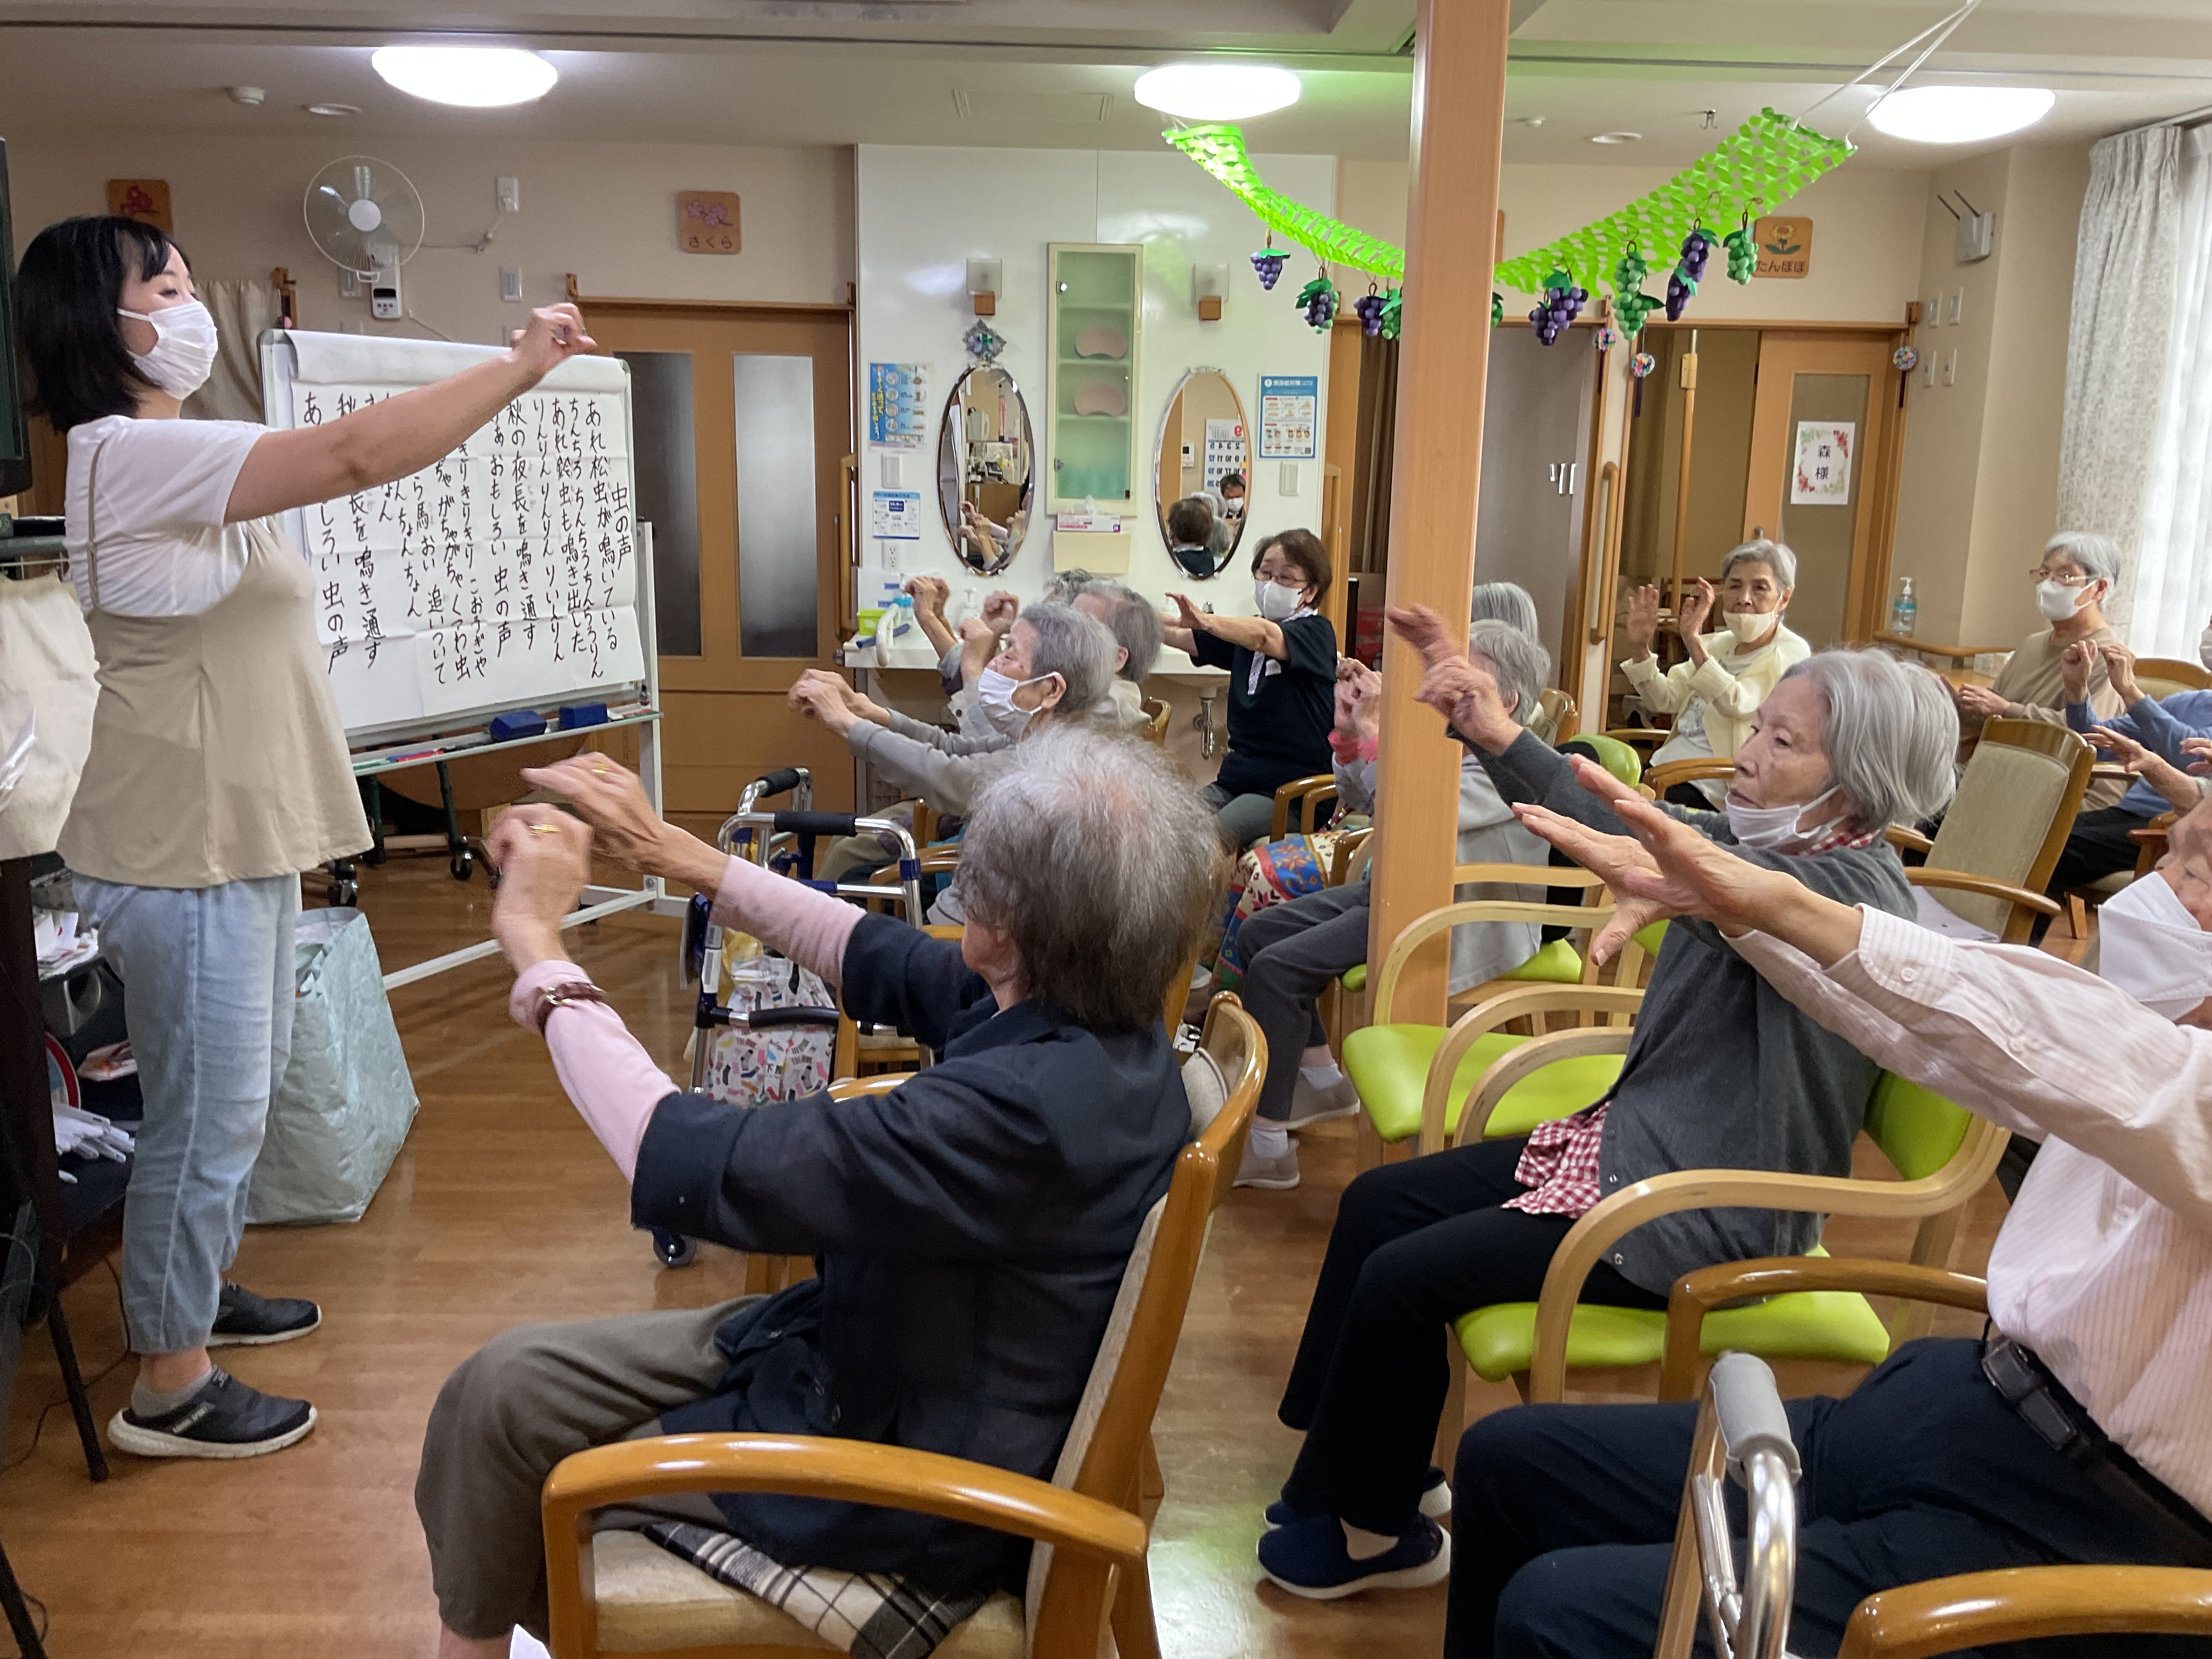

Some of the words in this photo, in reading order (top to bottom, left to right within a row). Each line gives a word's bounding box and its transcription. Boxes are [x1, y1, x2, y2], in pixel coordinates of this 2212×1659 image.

[689, 235, 732, 249] さくら
[414, 475, 445, 684] ら馬おい追いついて
[506, 398, 540, 650] 秋の夜長を鳴き通す
[552, 397, 587, 652] あれ鈴虫も鳴き出した
[585, 399, 617, 650] あれ松虫が鳴いている
[611, 482, 631, 570] 虫の声
